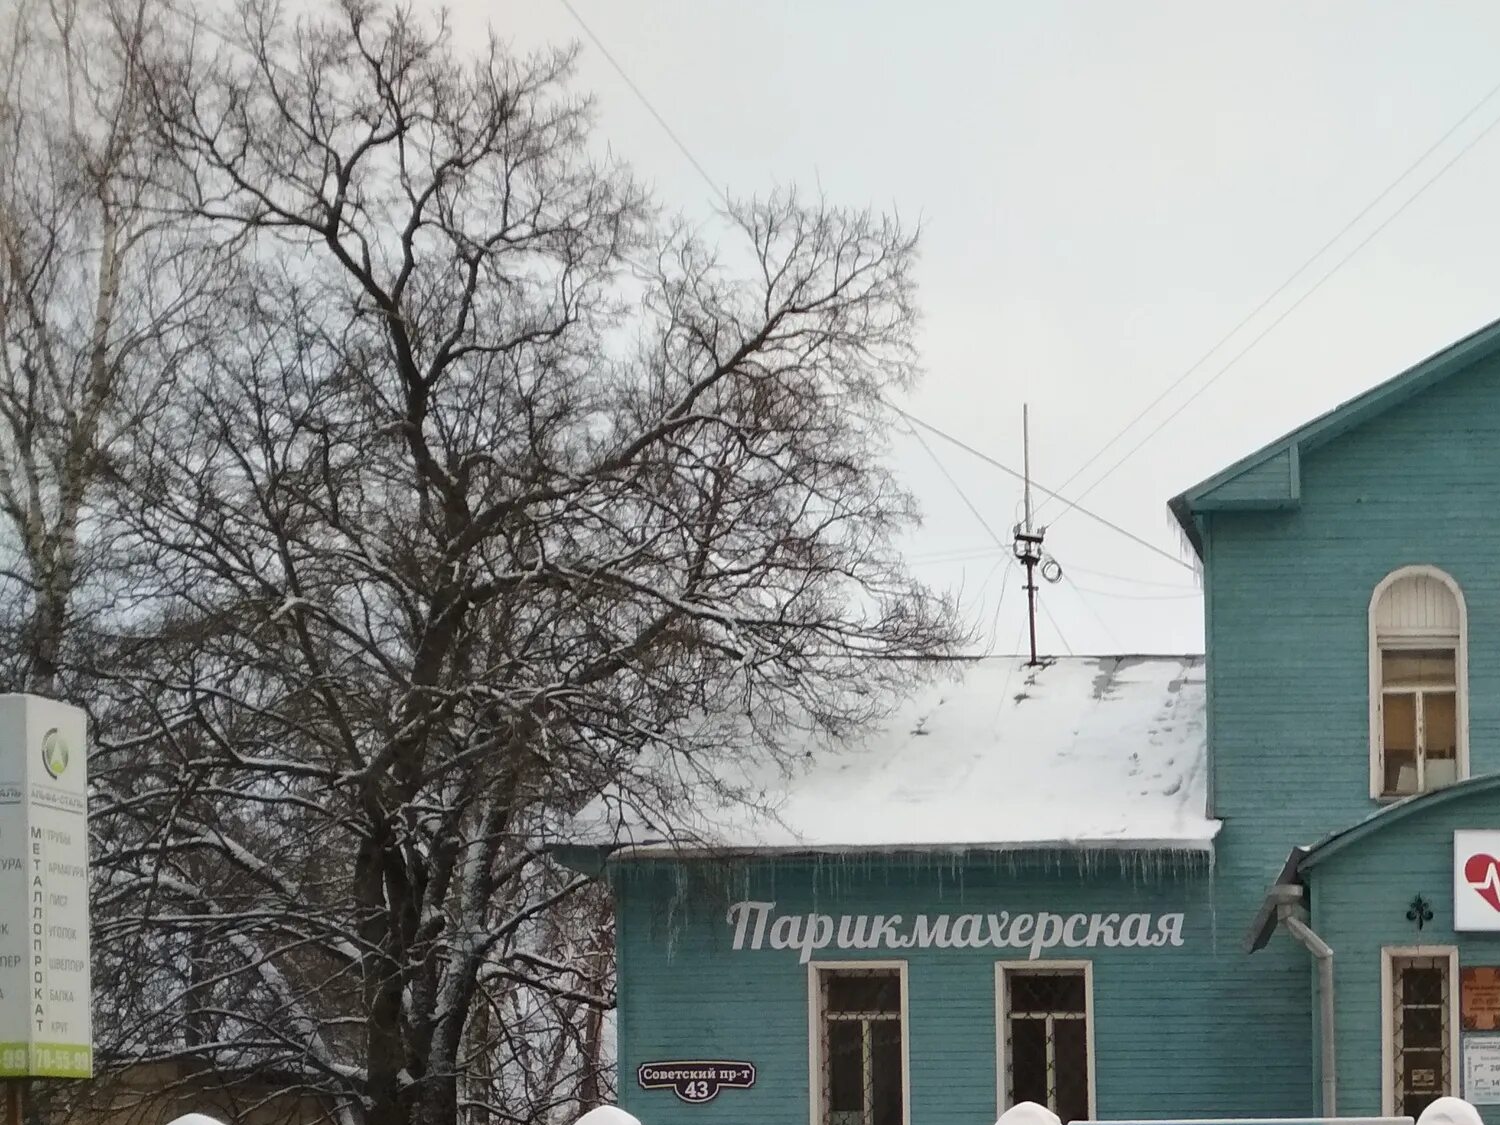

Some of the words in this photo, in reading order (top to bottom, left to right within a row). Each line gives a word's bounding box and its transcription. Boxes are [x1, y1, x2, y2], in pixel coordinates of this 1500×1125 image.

[726, 901, 1186, 965] Парикмахерская
[643, 1067, 716, 1080] Советский
[719, 1069, 750, 1082] пр-т
[684, 1081, 709, 1098] 43
